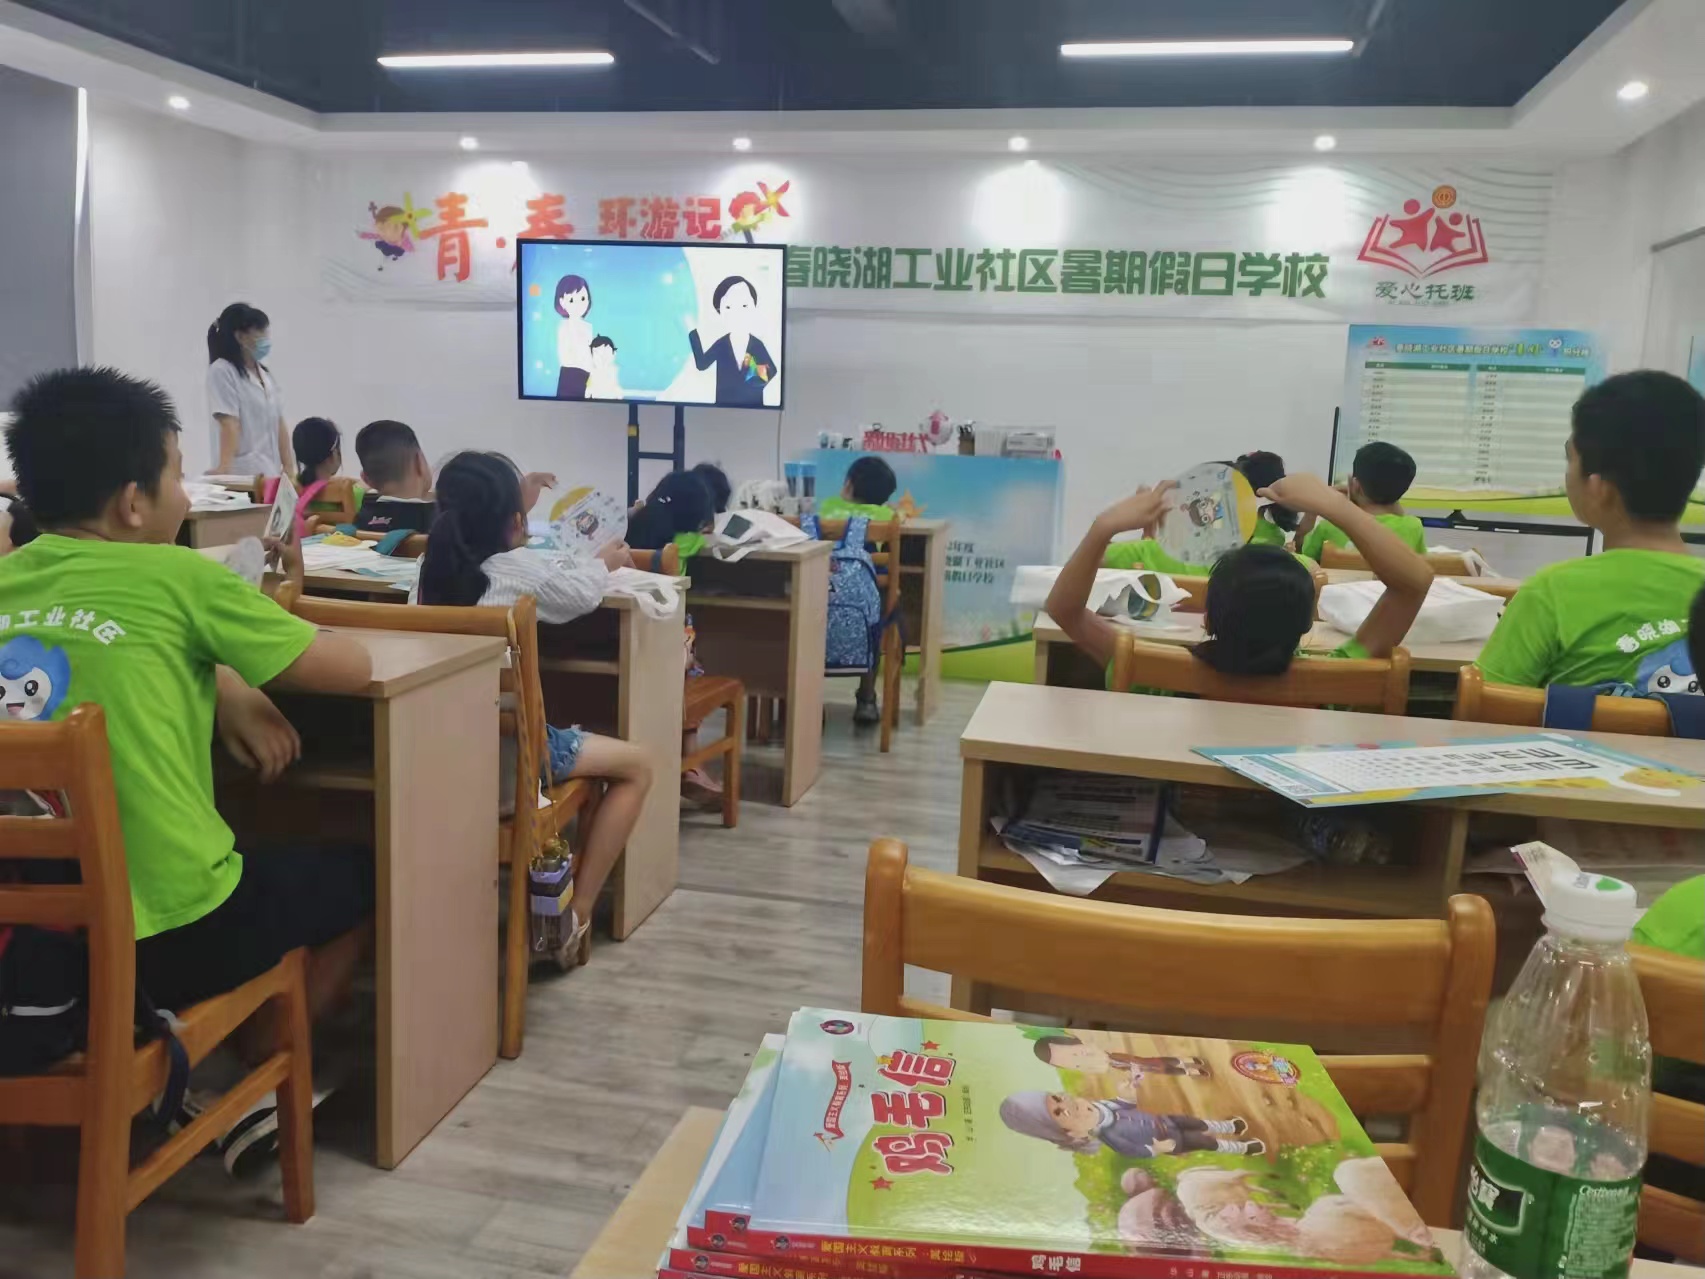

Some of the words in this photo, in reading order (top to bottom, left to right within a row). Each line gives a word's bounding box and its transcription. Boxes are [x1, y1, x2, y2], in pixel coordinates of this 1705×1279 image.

[597, 195, 722, 240] 环游记
[786, 244, 1331, 299] 春晓湖工业社区暑期假日学校
[1375, 280, 1478, 302] 爱心托班
[870, 1048, 958, 1177] 鸡毛信
[1030, 1253, 1082, 1273] 鸡毛信
